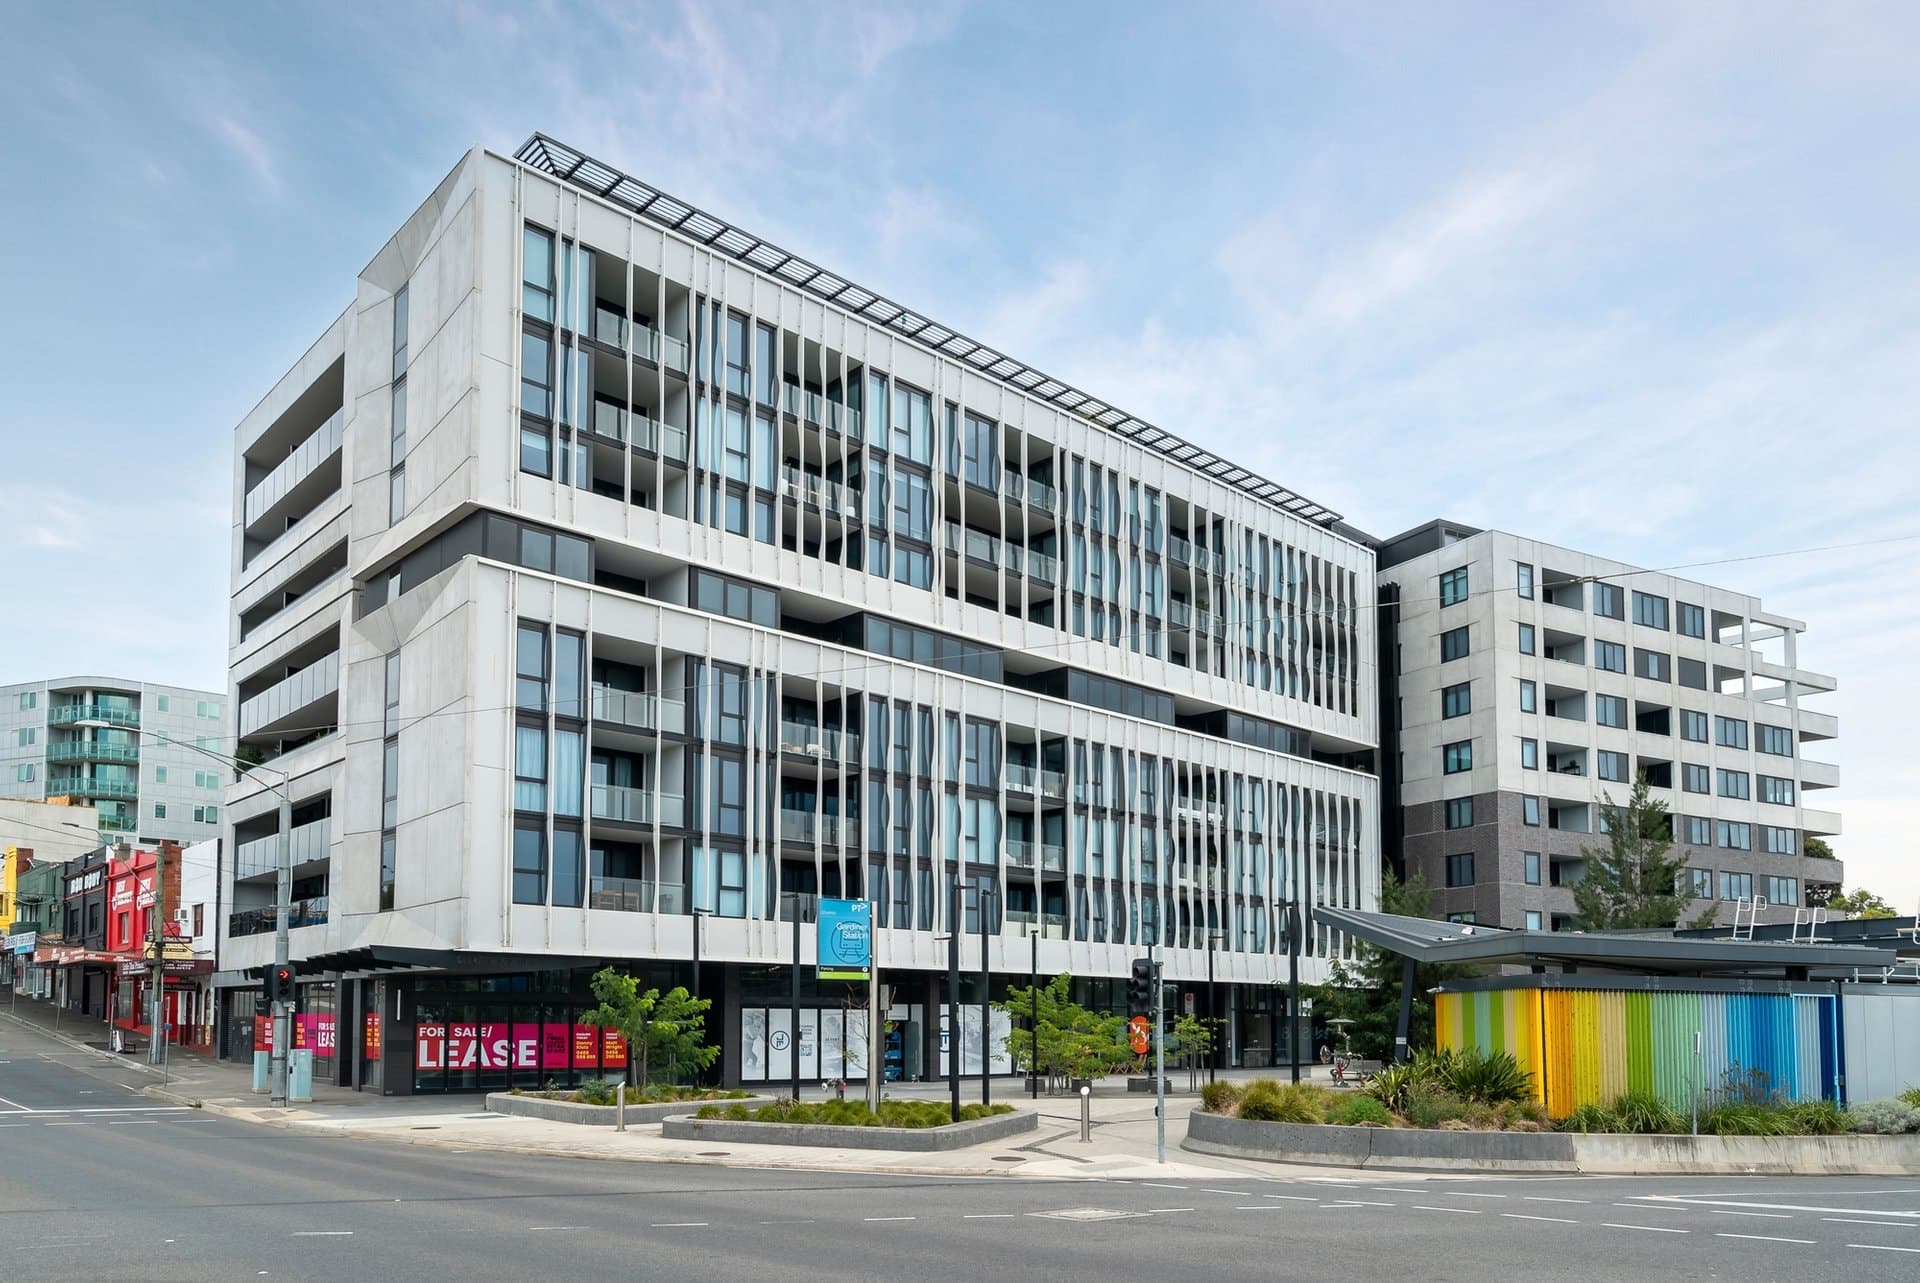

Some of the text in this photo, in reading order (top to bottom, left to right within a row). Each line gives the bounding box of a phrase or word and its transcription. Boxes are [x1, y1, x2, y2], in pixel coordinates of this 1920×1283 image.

[836, 922, 868, 931] Gardiner
[843, 930, 867, 939] Station
[418, 1025, 493, 1038] FOR SALE/
[418, 1039, 537, 1067] LEASE
